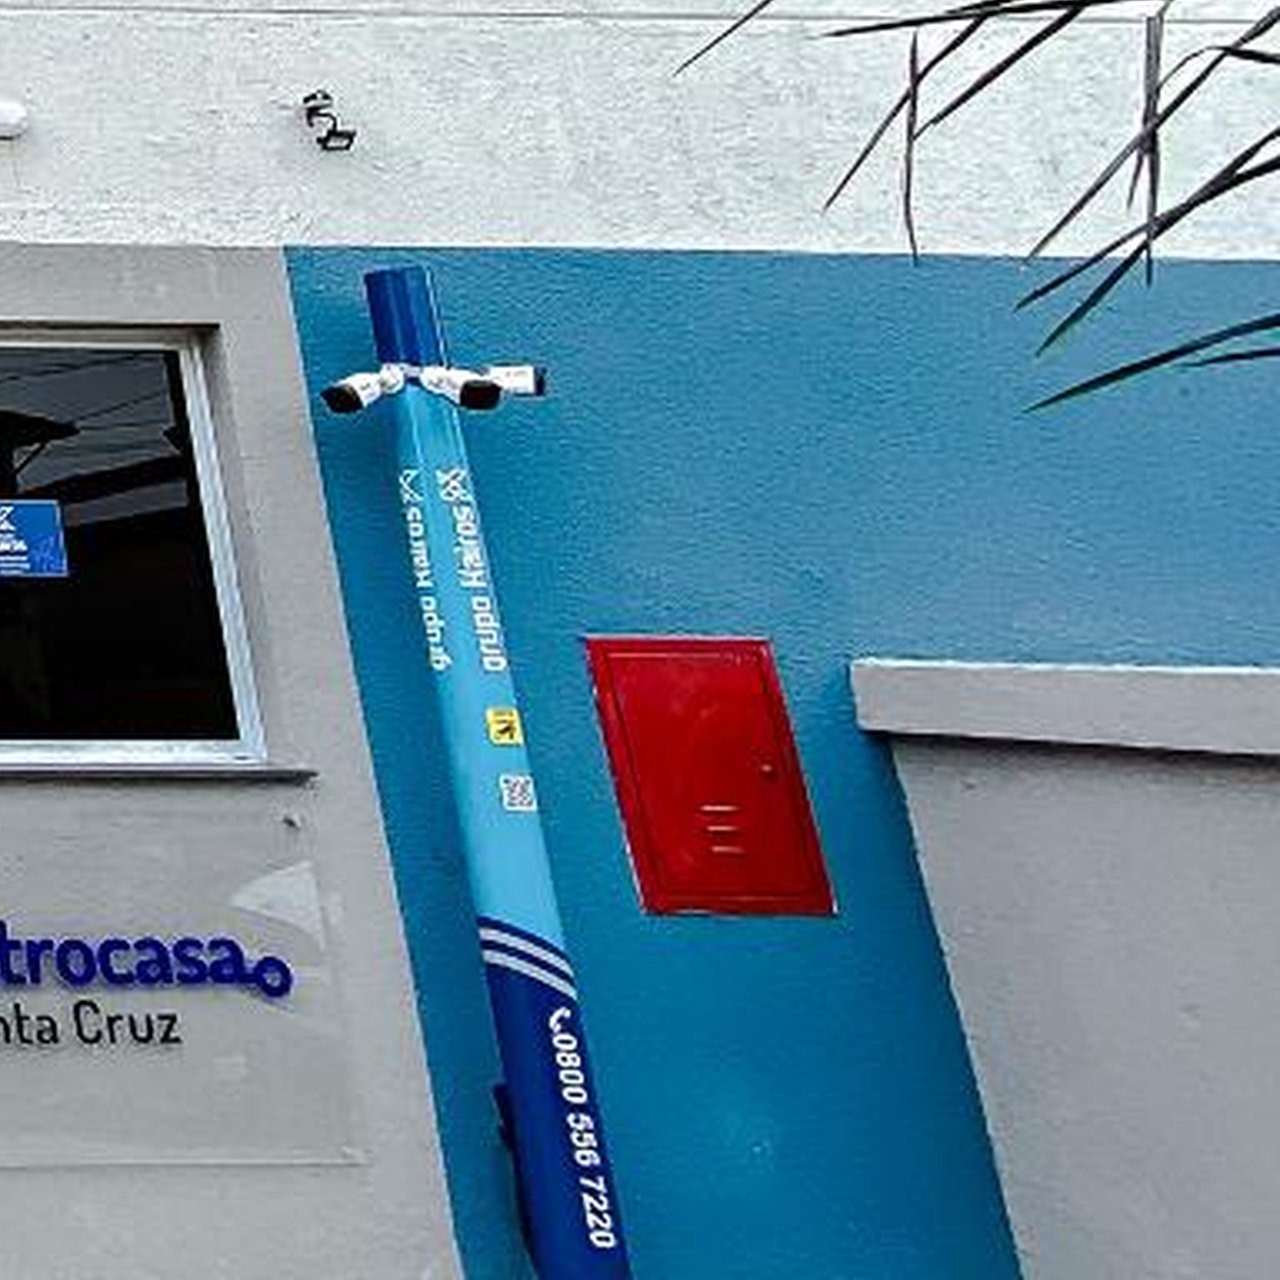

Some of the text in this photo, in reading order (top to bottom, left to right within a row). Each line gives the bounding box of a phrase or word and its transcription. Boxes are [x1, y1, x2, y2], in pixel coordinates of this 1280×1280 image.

[419, 596, 453, 671] grupo
[472, 596, 507, 671] grupo
[72, 999, 182, 1045] Cruz
[552, 1033, 617, 1248] 0800 556 7220
